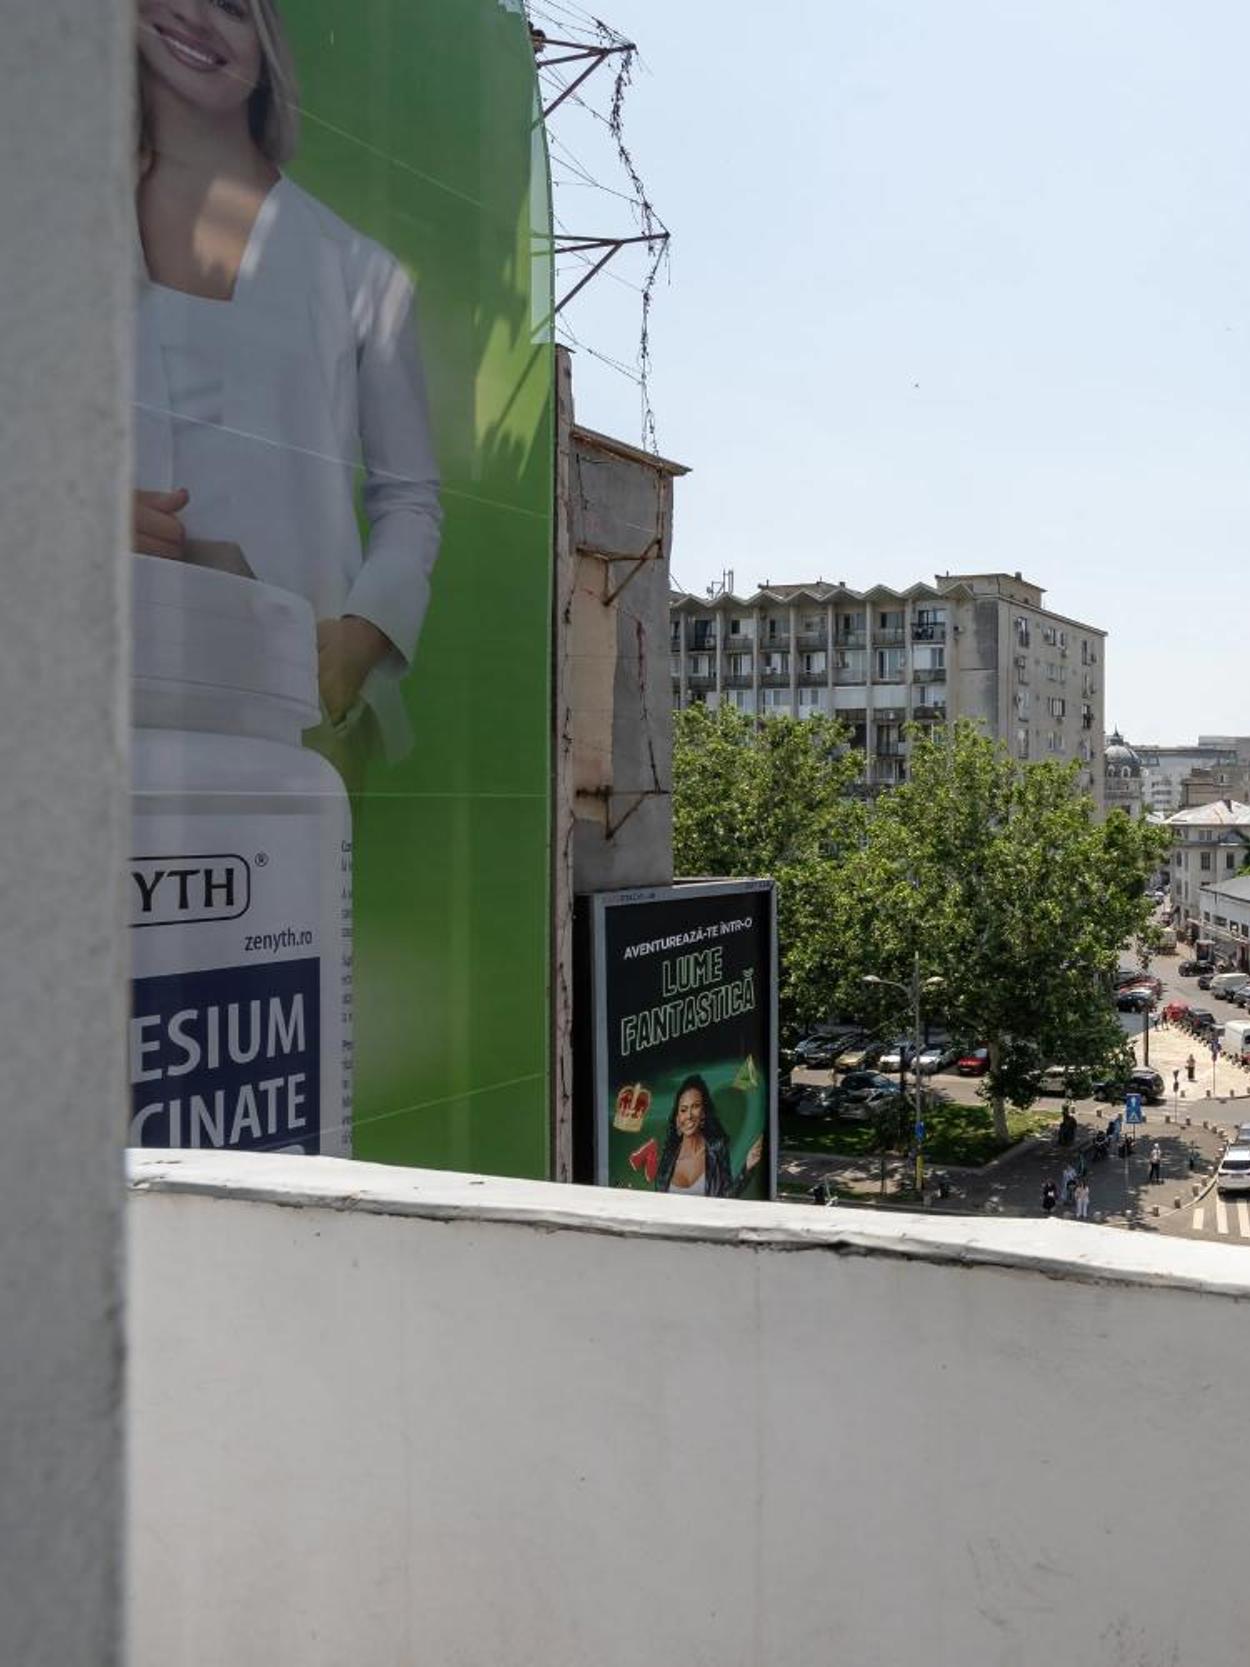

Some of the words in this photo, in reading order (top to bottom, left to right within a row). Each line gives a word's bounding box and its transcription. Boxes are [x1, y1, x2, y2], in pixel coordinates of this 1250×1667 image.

[132, 868, 235, 912] YTH
[245, 927, 312, 951] zenyth.ro
[662, 946, 723, 997] LUME
[621, 967, 755, 1056] FANTASTICĂ
[132, 993, 306, 1084] ESIUM
